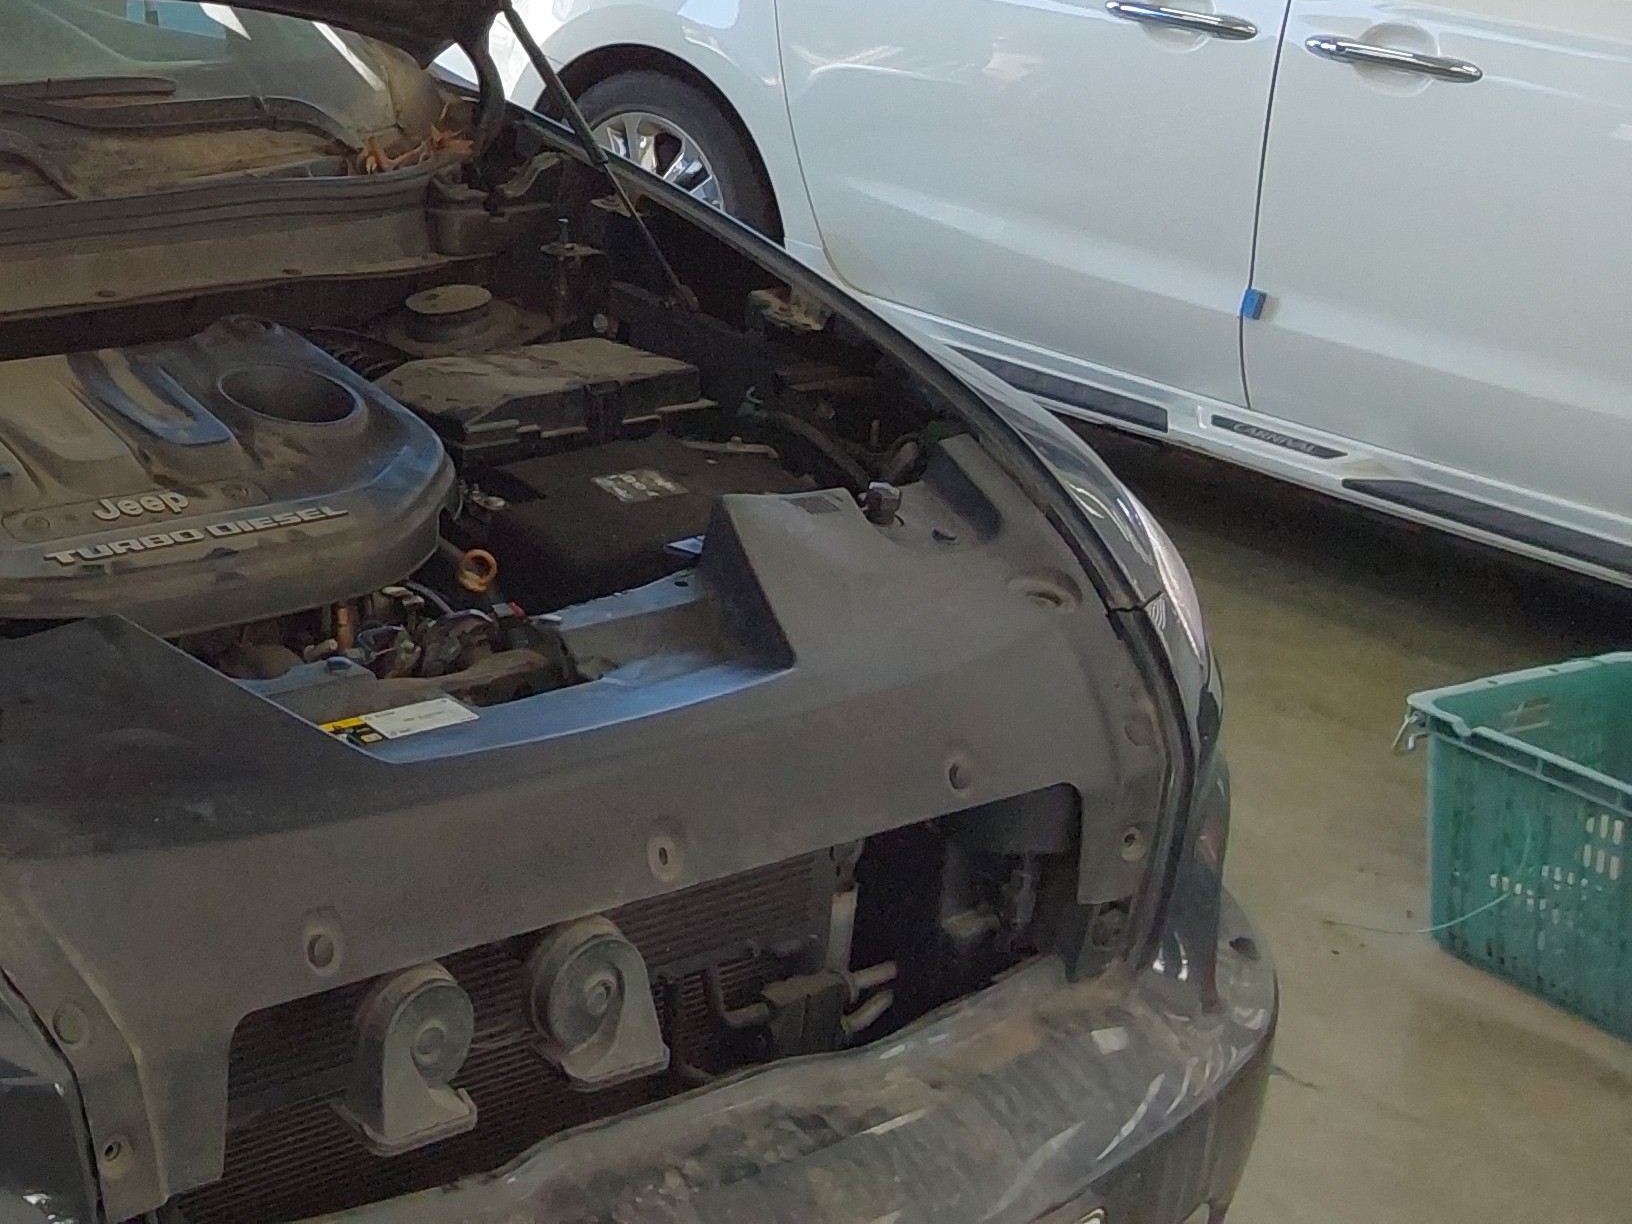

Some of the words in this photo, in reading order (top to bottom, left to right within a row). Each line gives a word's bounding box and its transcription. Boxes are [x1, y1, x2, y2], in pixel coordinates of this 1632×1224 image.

[1232, 423, 1317, 453] CARNIVAL
[92, 491, 189, 521] Jeep
[44, 529, 205, 566] TURBO
[206, 506, 349, 538] DIESEL
